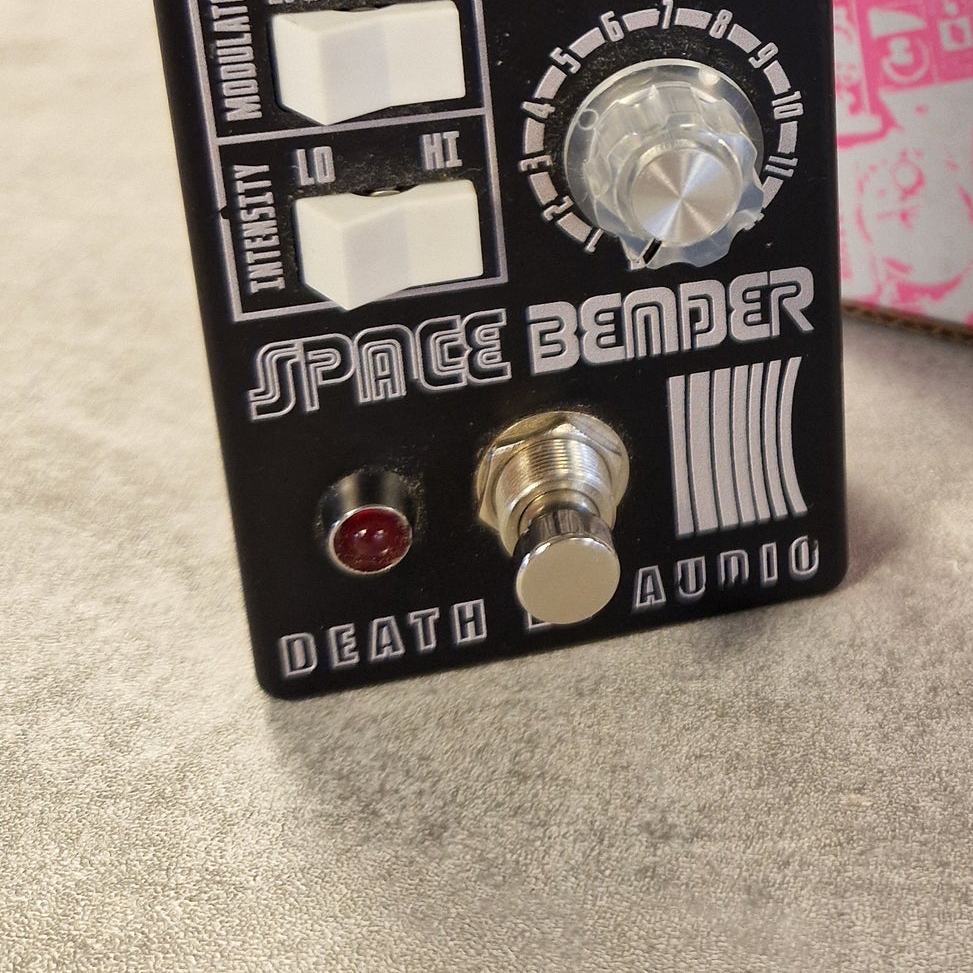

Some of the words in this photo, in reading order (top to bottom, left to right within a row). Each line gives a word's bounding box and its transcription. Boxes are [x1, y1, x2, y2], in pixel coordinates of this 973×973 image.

[599, 10, 625, 42] 6
[662, 0, 674, 29] 7
[709, 9, 733, 40] 8
[550, 46, 582, 74] 5
[748, 42, 779, 69] 9
[520, 100, 556, 119] 4
[772, 90, 804, 120] 10
[295, 145, 336, 186] LO
[420, 130, 463, 171] HI
[518, 155, 552, 172] 3
[765, 155, 799, 178] 11
[541, 196, 573, 222] 2
[232, 164, 286, 294] INTENSITY
[248, 308, 511, 421] SPACE
[527, 267, 815, 376] BENDER
[278, 599, 487, 679] DEATH
[631, 536, 820, 614] AUDIO
